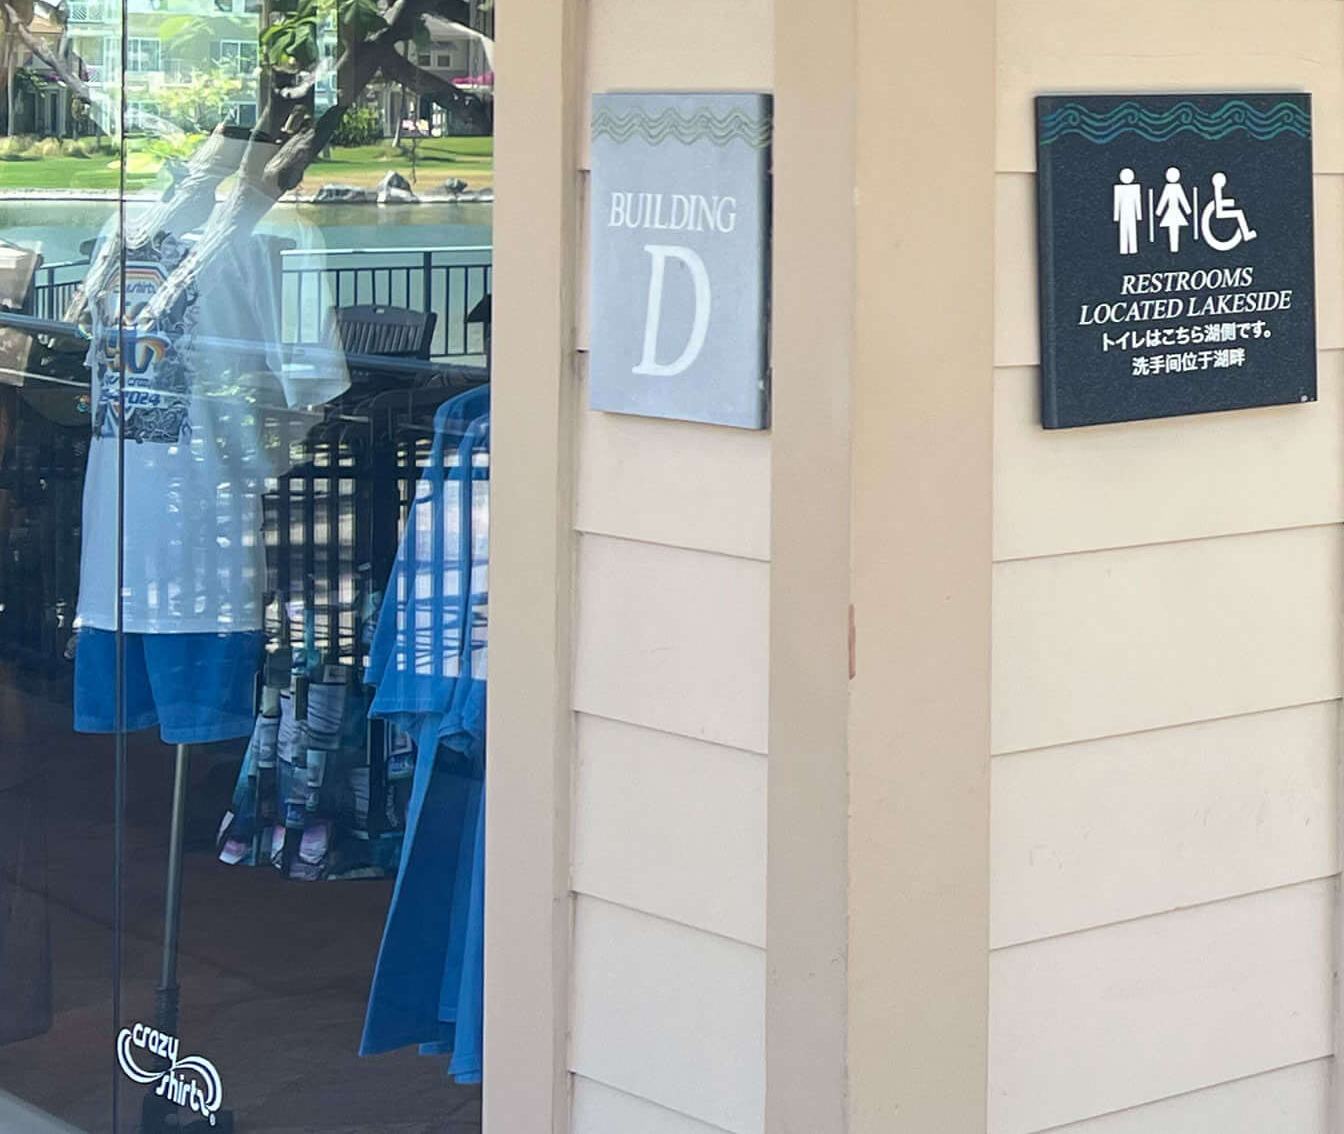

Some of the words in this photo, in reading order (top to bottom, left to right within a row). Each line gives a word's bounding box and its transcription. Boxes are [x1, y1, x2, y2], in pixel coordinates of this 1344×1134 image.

[608, 192, 737, 233] BUILDING
[1120, 267, 1253, 295] RESTROOMS
[632, 244, 712, 376] D
[1079, 298, 1184, 327] LOCATED
[1187, 290, 1293, 317] LAKESIDE
[1102, 320, 1272, 352] トイレはこちら湖側です。
[1131, 347, 1246, 377] 洗手间位于湖畔
[132, 1023, 179, 1069] crazy
[156, 1070, 209, 1118] shirts
